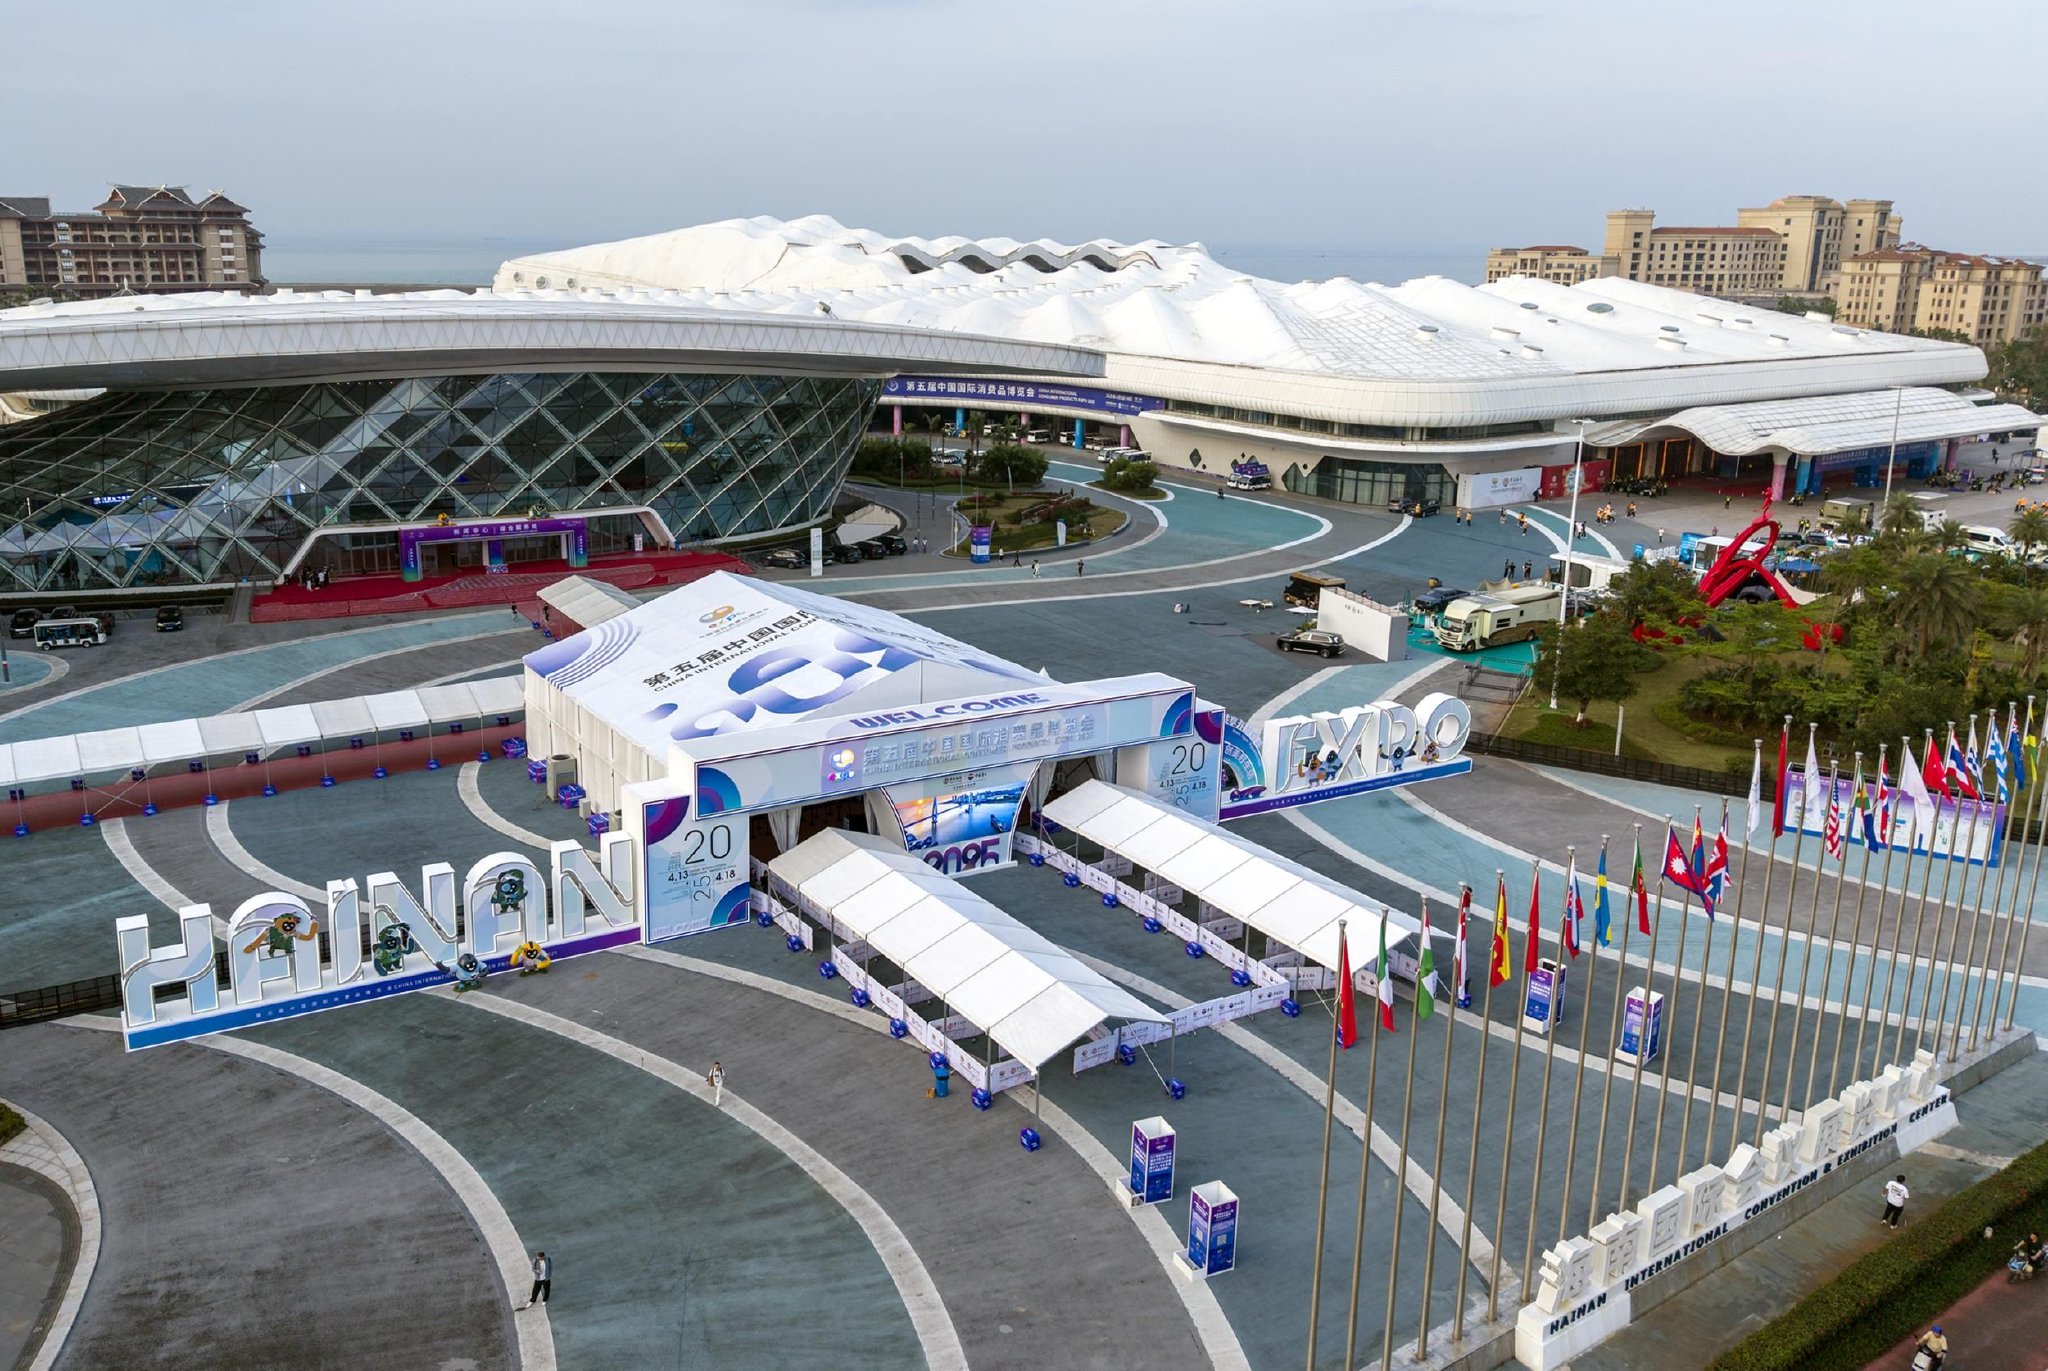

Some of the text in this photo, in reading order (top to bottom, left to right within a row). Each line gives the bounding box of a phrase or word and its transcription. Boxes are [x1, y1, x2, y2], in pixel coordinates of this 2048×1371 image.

[906, 380, 1035, 398] 第五届中国国际消费品博览会
[654, 673, 692, 692] CHINA
[694, 632, 790, 675] INTERNATIONAL
[850, 693, 1049, 729] WELCOME
[863, 713, 1096, 766] 第五届中国国际消费品博览会
[1171, 742, 1205, 775] 20
[1263, 692, 1472, 794] EXPO
[684, 825, 731, 865] 20
[668, 870, 689, 882] 4.13
[715, 870, 736, 881] 4.18
[116, 831, 635, 1027] HAINAN
[1550, 1094, 1947, 1334] HAINAN INTERNATIONAL CONVENTION & EXHIBITION CENTER
